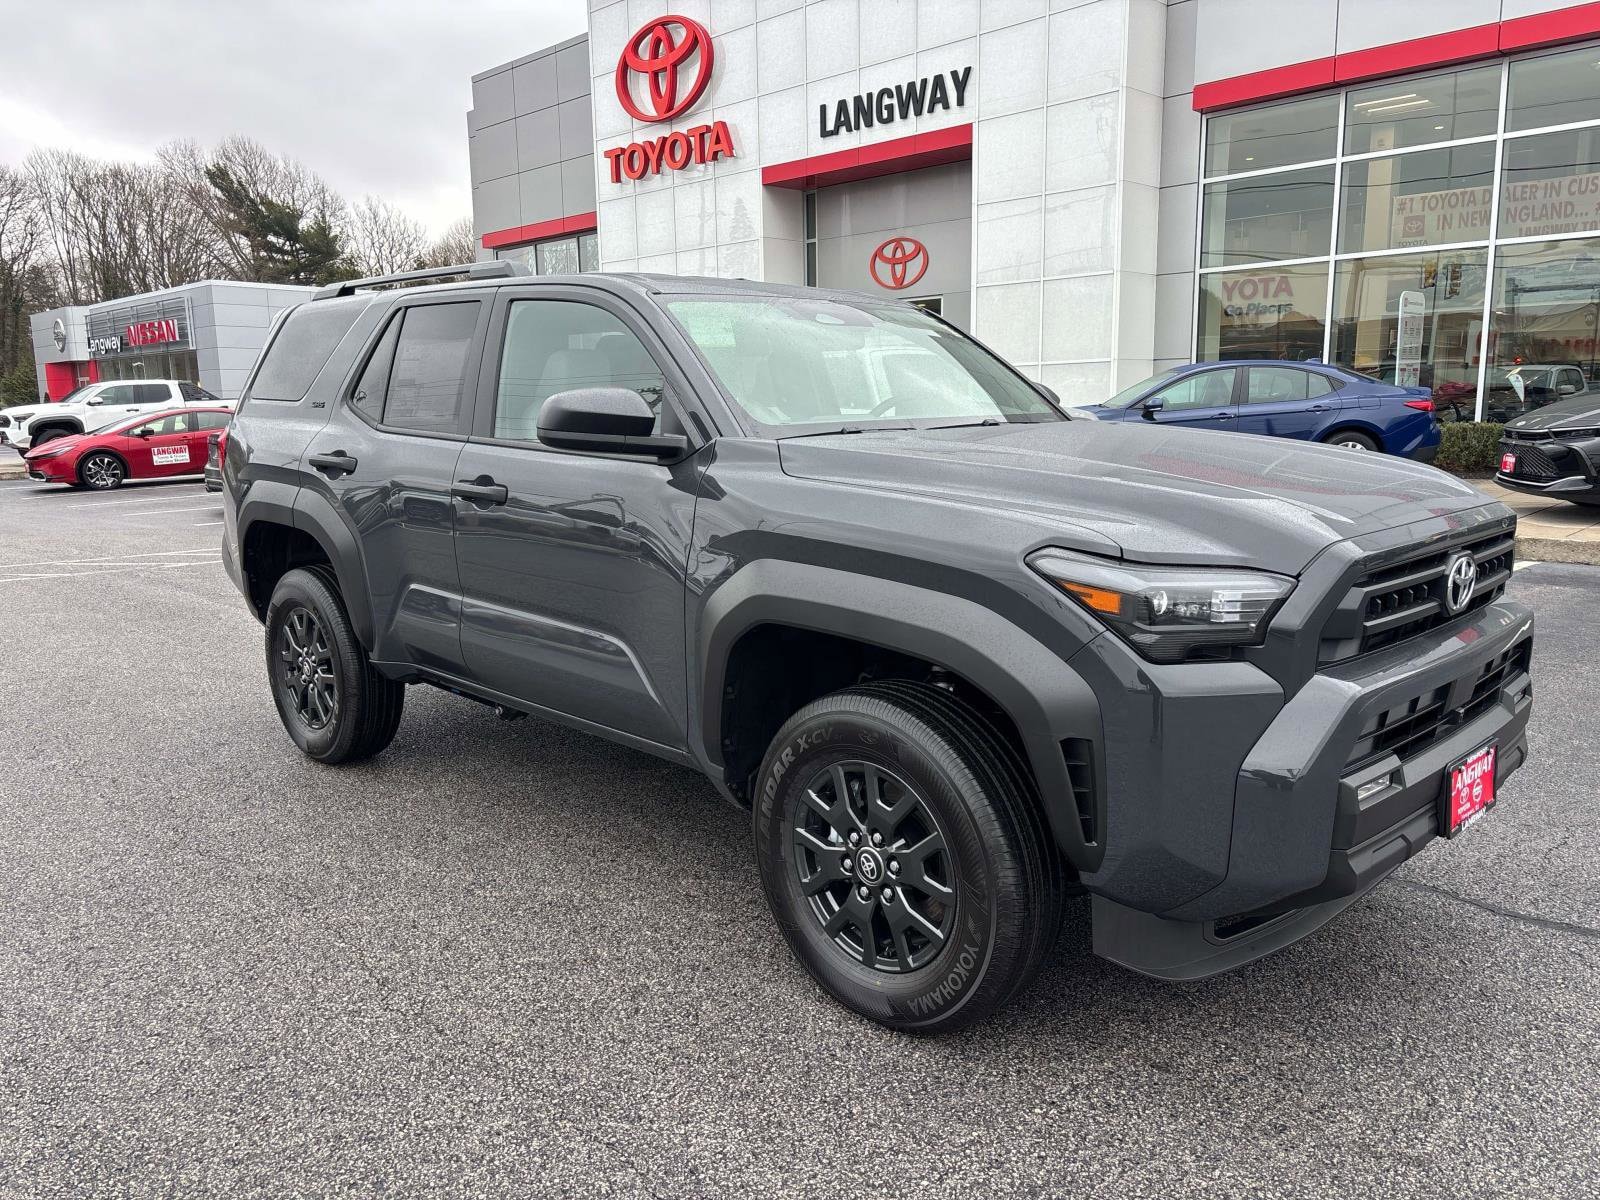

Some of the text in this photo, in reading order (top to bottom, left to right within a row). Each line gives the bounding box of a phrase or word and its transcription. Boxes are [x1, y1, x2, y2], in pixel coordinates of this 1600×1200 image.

[820, 66, 972, 138] LANGWAY
[604, 121, 737, 184] TOYOTA
[1420, 188, 1477, 212] TOYOTA
[1543, 181, 1562, 199] IN
[1437, 213, 1452, 231] IN
[1458, 210, 1491, 229] NEW
[1505, 201, 1589, 225] NGLAND...
[88, 319, 179, 355] Langway NISSAN
[152, 446, 188, 456] LANGWAY
[1451, 754, 1493, 797] LANGWAY
[907, 943, 979, 1017] YOKOHAMA
